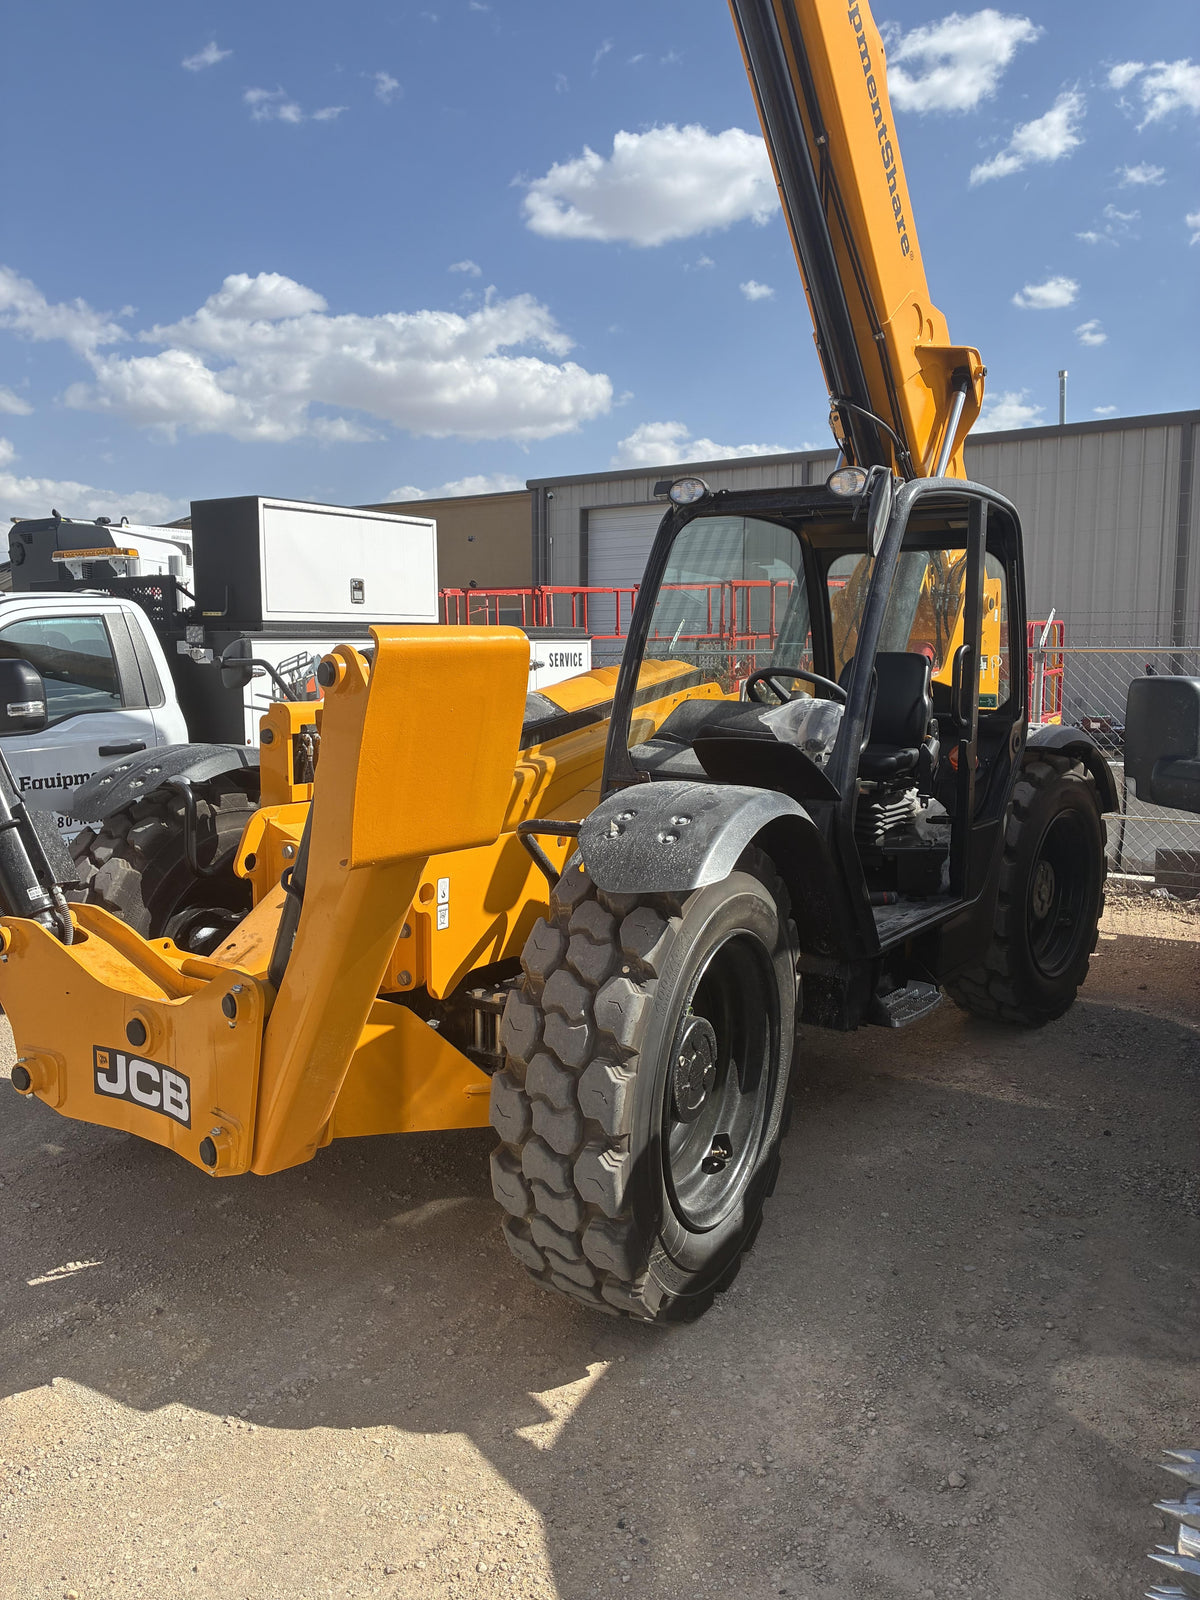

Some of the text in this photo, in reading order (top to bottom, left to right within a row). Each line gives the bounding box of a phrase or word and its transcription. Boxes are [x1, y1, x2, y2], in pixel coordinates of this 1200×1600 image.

[549, 652, 583, 668] SERVICE
[19, 772, 98, 792] Equipm
[97, 1053, 190, 1122] JCB
